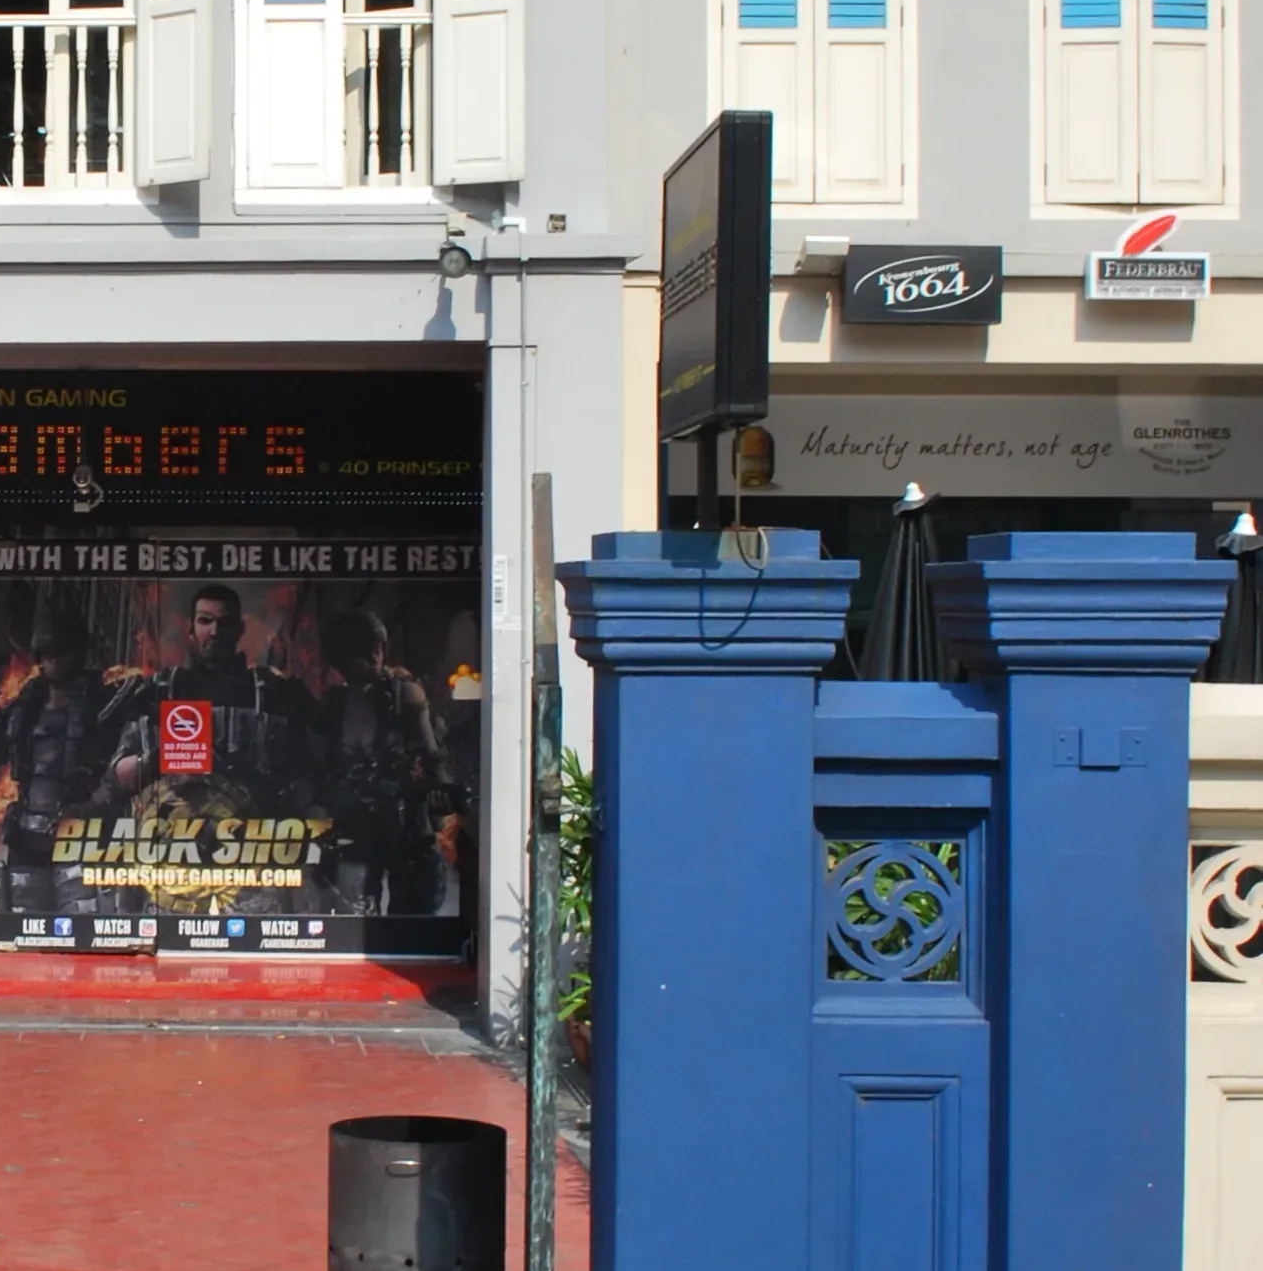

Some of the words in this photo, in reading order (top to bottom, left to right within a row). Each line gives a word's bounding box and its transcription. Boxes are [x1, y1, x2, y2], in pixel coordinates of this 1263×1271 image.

[885, 270, 971, 306] 1664
[26, 389, 127, 407] GAMING
[1133, 427, 1232, 440] GLENROTHES
[800, 425, 910, 470] Maturity
[918, 433, 1013, 459] matters,
[1024, 433, 1060, 457] not
[1070, 441, 1113, 469] age
[338, 460, 370, 475] 40
[377, 460, 470, 475] PRINSEP
[74, 545, 128, 571] THE
[138, 543, 213, 573] BEST,
[221, 544, 262, 571] DIE
[274, 545, 332, 571] LIKE
[343, 545, 398, 571] THE
[52, 818, 205, 864] BLACK
[212, 817, 334, 865] SHOT
[83, 867, 302, 887] BLACKSHOT.GARENA.COM
[22, 919, 46, 935] LIKE
[93, 919, 132, 935] WATCH
[178, 920, 220, 935] FOLLOW
[261, 920, 299, 936] WATCH
